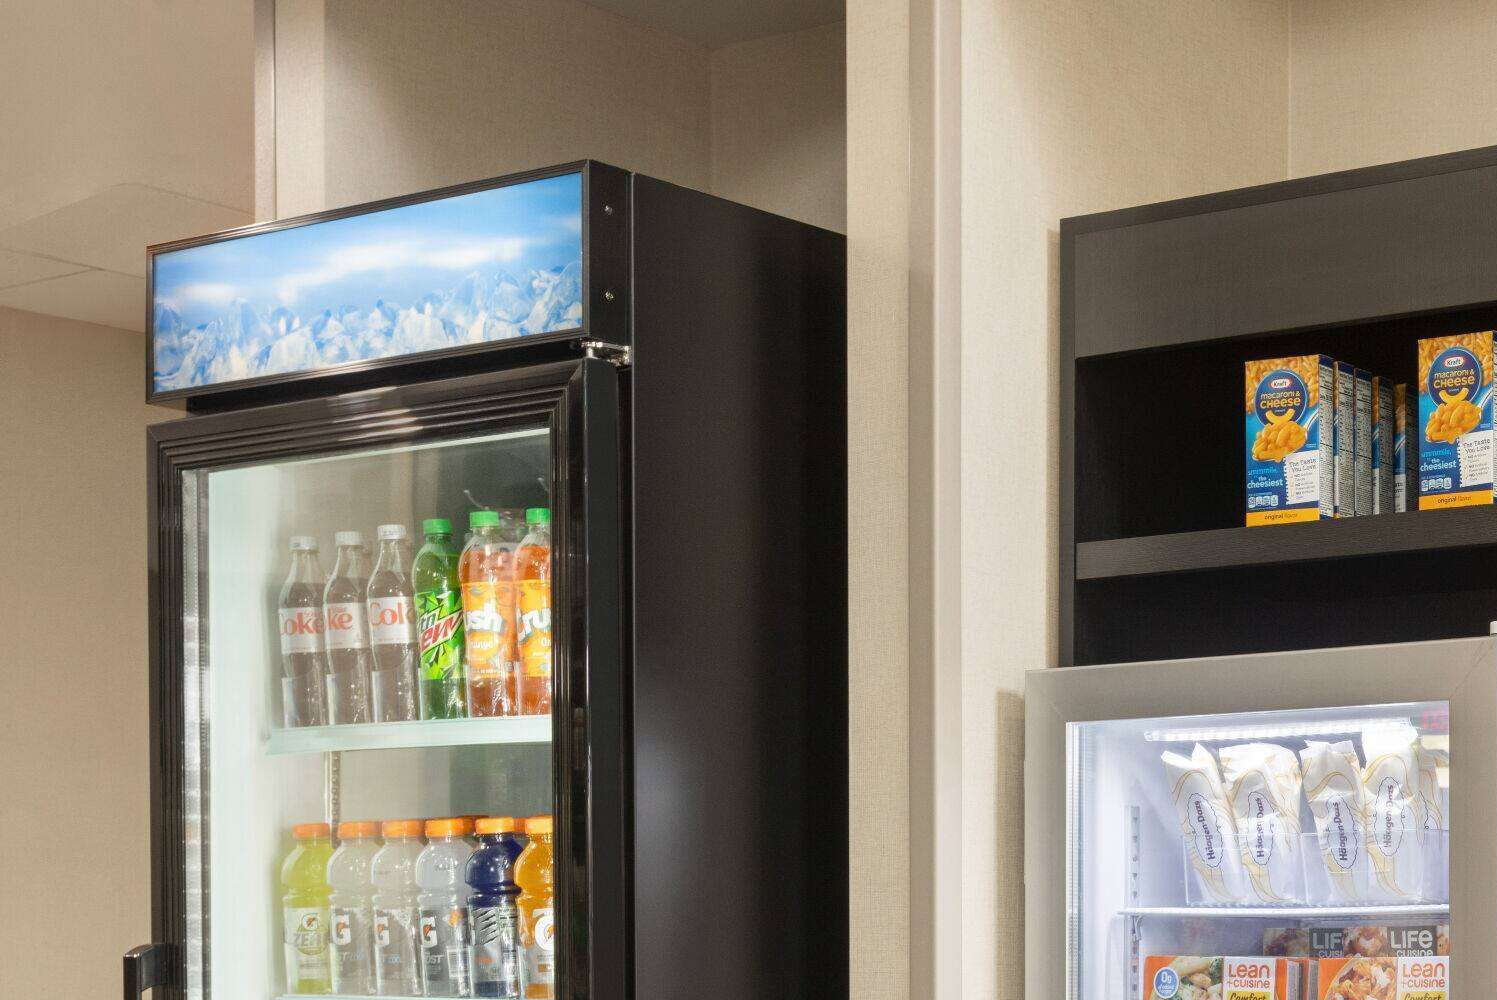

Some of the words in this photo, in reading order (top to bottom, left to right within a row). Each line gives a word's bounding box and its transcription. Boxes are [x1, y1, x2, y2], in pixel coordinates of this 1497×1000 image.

[1434, 370, 1469, 379] macaroni
[1260, 390, 1295, 401] macaroni
[1420, 460, 1457, 472] cheesiest
[1247, 478, 1284, 490] cheesiest
[1228, 963, 1271, 979] Lean
[1402, 963, 1446, 978] Lean
